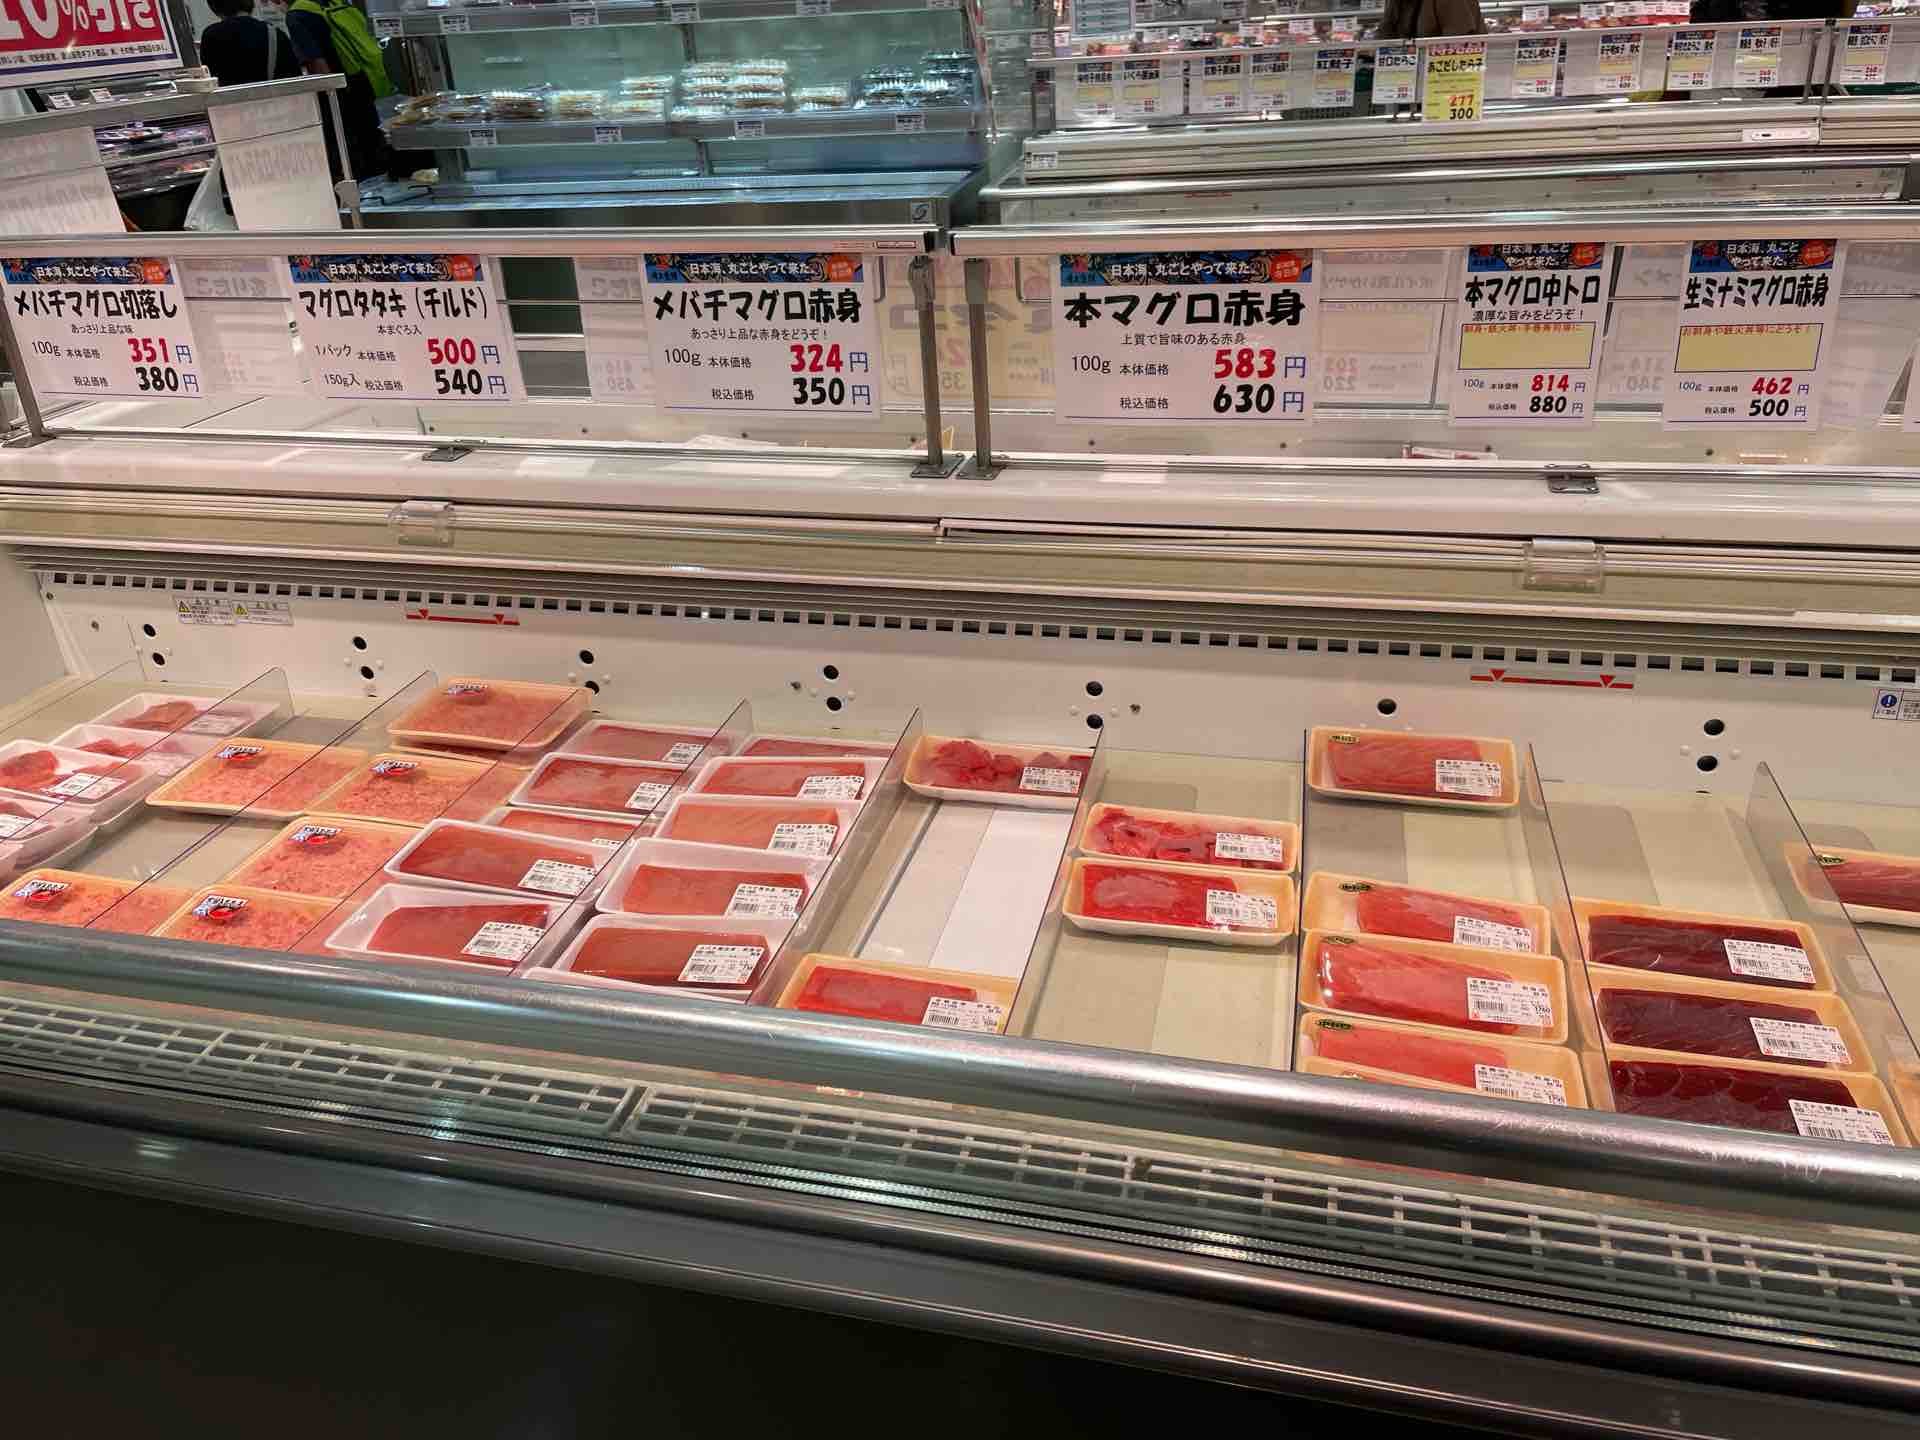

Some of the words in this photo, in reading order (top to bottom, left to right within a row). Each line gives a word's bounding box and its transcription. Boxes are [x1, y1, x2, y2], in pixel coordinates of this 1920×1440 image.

[1448, 95, 1474, 107] 277
[1449, 107, 1474, 120] 300
[14, 289, 178, 319] メバチマグロ切落し
[1465, 273, 1601, 309] 本マグロ中トロ
[1683, 272, 1829, 310] 生ミナミマグロ赤身
[653, 288, 862, 323] メバチマグロ赤身
[1064, 289, 1306, 328] 本マグロ赤身
[376, 324, 423, 336] 本まぐろ入
[1120, 332, 1249, 346] 上質で旨味のある赤身
[32, 341, 62, 357] 100g
[66, 348, 101, 360] 本体価格
[127, 337, 170, 363] 351
[176, 345, 193, 364] 円
[315, 344, 352, 358] 1パック
[357, 350, 397, 362] 本体価格
[427, 338, 477, 365] 500
[481, 345, 501, 365] 円
[664, 348, 702, 367] 100g
[707, 357, 752, 369] 本体価格
[790, 343, 843, 373] 324
[849, 351, 869, 373] 円
[1071, 355, 1112, 374] 100g
[1119, 363, 1169, 376] 本体価格
[1214, 348, 1277, 379] 583
[1283, 356, 1306, 379] 円
[74, 376, 110, 388] 税込価格
[135, 367, 180, 391] 380
[183, 374, 200, 393] 円
[323, 373, 361, 388] 150g入
[364, 380, 404, 391] 税込価格
[434, 368, 483, 395] 540
[487, 375, 508, 395] 円
[711, 388, 754, 401] 税込価格
[793, 377, 846, 405] 350
[851, 384, 871, 405] 円
[1531, 374, 1569, 392] 814
[1751, 377, 1793, 395] 462
[1119, 397, 1169, 409] 税込価格
[1213, 383, 1276, 413] 630
[1282, 391, 1305, 413] 円
[1529, 396, 1568, 413] 880
[1748, 399, 1790, 417] 500
